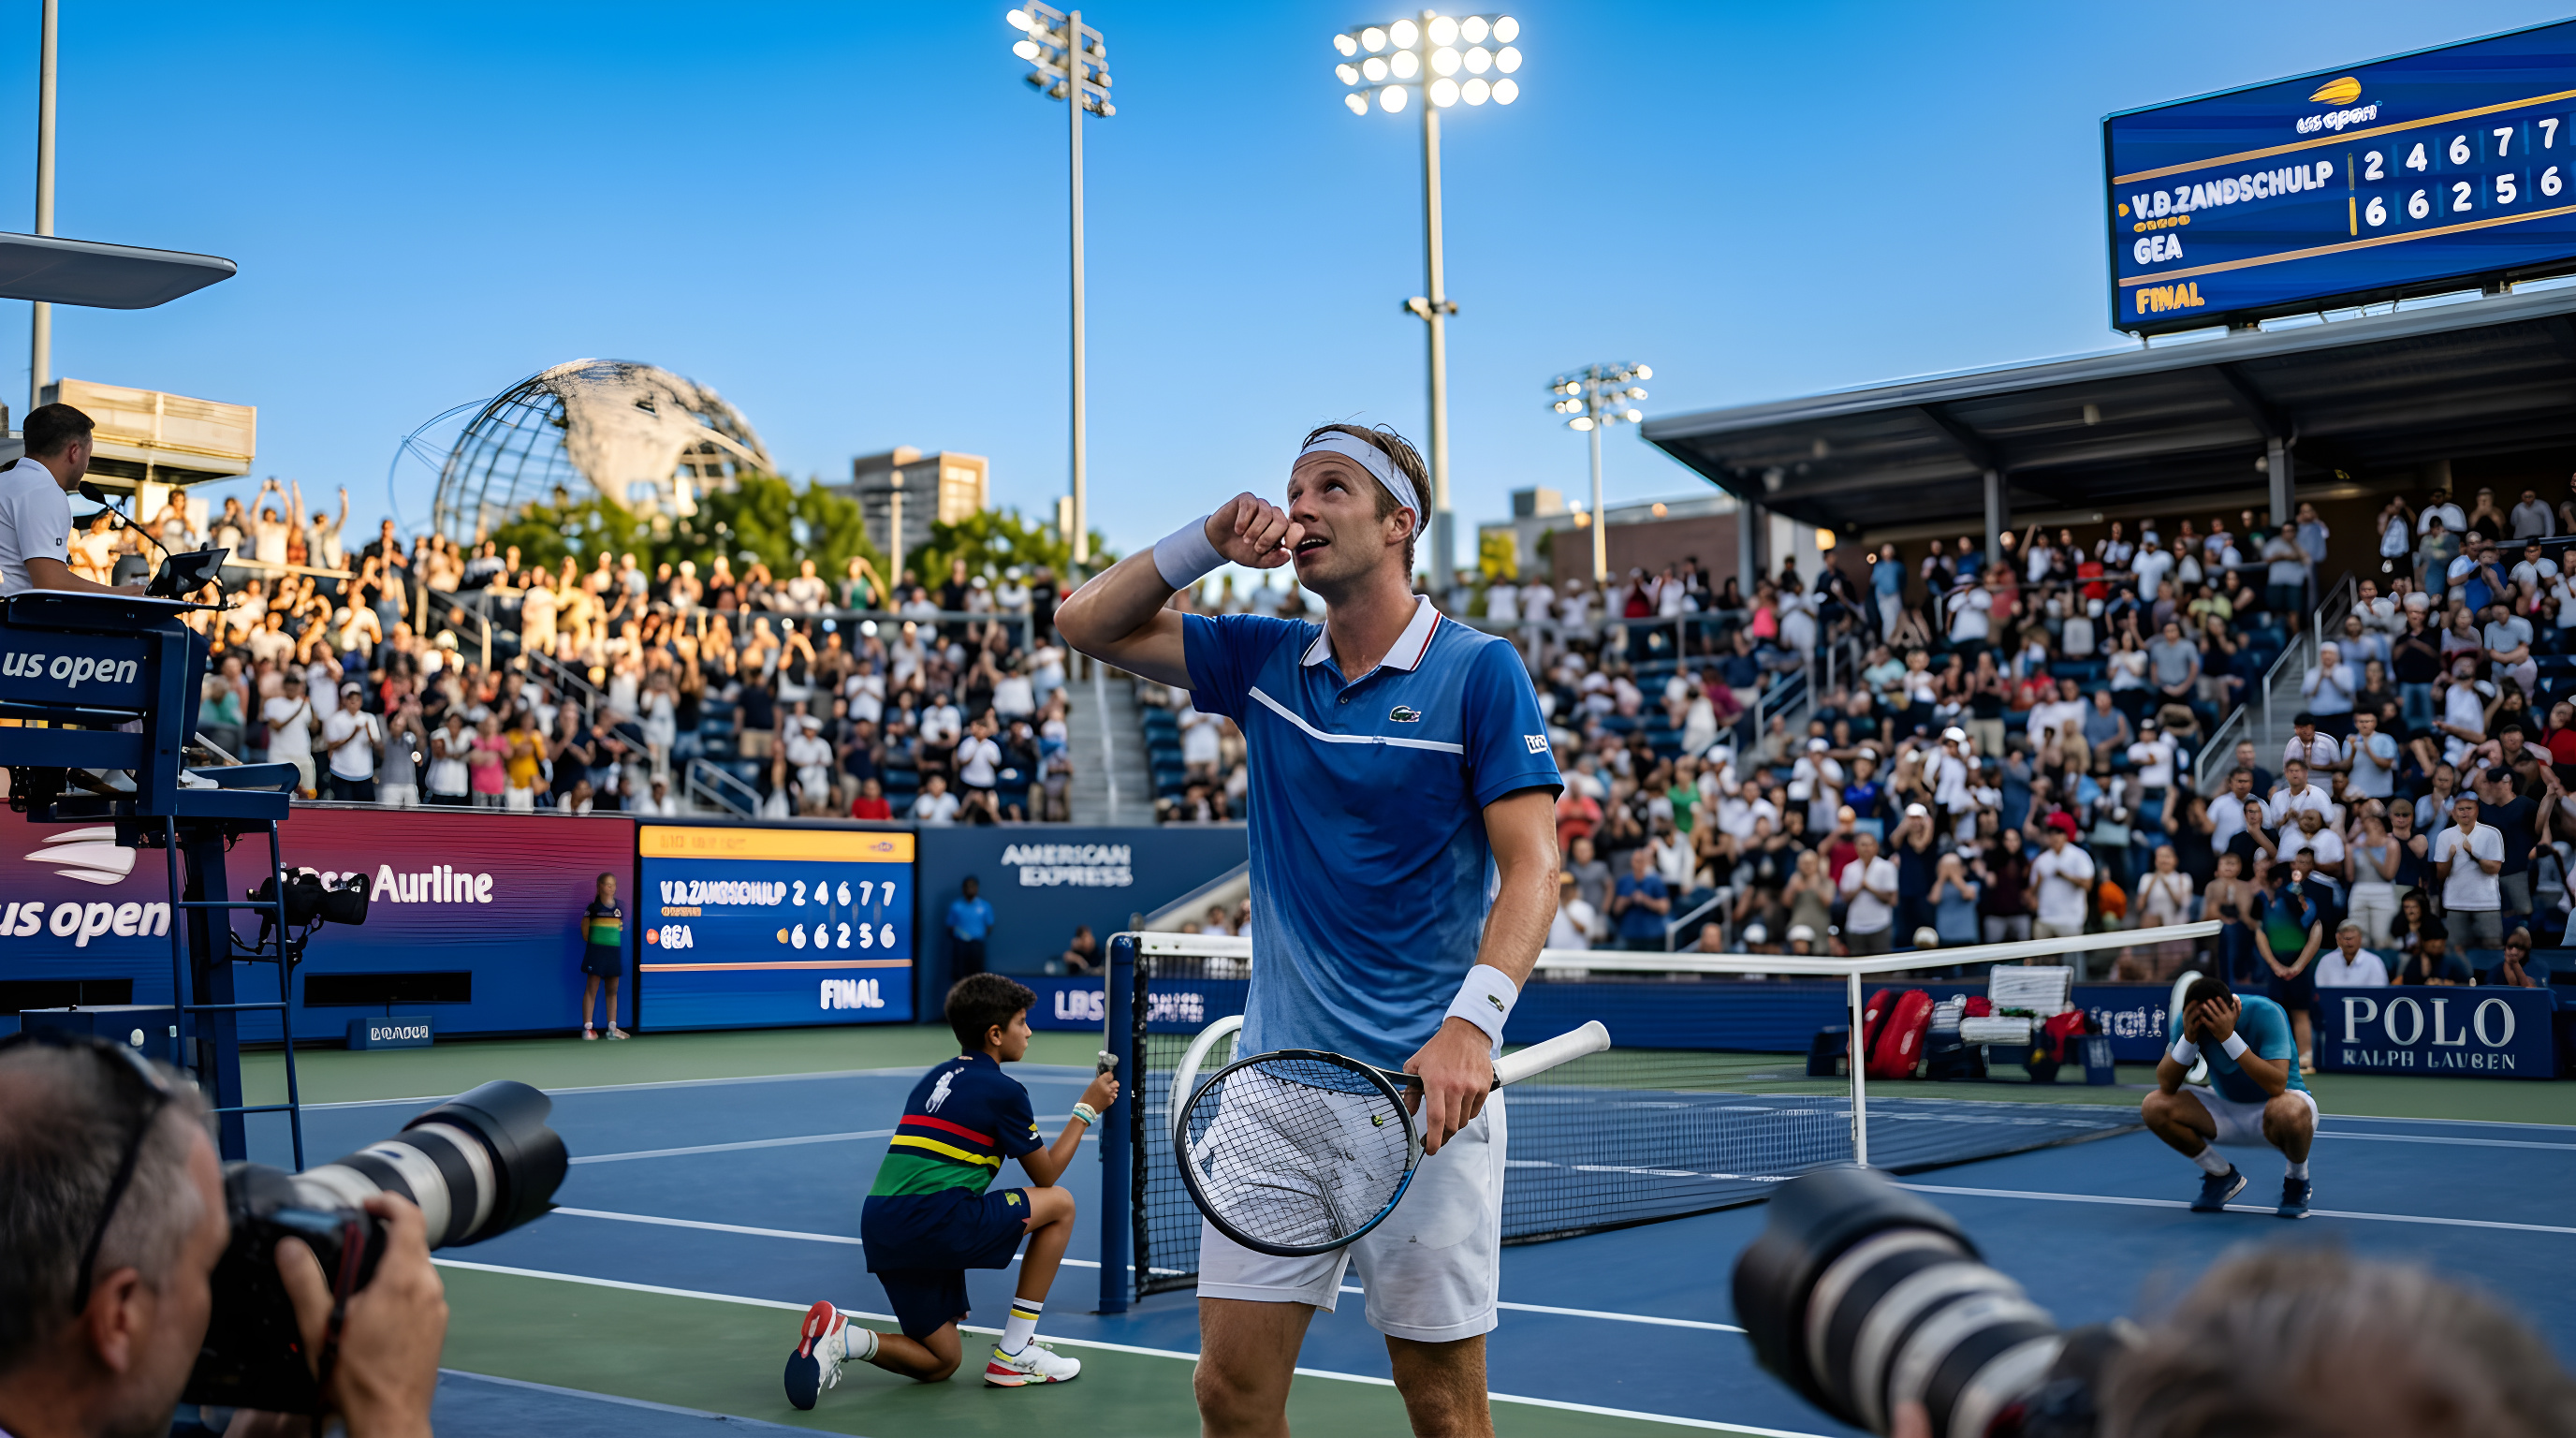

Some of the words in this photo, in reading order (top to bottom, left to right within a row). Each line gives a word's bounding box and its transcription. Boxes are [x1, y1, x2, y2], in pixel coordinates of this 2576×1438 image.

[2364, 151, 2384, 181] 2
[2406, 142, 2427, 171] 4
[2449, 135, 2470, 165] 6
[2493, 126, 2513, 156] 7
[2539, 118, 2559, 149] 7
[2133, 233, 2183, 264] GEA
[2365, 197, 2387, 227] 6
[2408, 189, 2430, 219] 6
[2452, 182, 2472, 212] 2
[2496, 173, 2517, 204] 5
[2540, 166, 2563, 196] 6
[2135, 282, 2205, 314] FINAL
[2, 652, 46, 678] us
[49, 655, 139, 688] open
[1001, 844, 1132, 866] AMERICAN
[370, 864, 493, 903] Aurline
[792, 879, 807, 906] 2
[813, 880, 829, 905] 4
[837, 880, 852, 906] 6
[859, 880, 874, 906] 7
[881, 880, 896, 906] 7
[49, 902, 171, 947] open
[791, 923, 807, 949] 6
[813, 923, 829, 949] 6
[836, 922, 851, 948] 2
[880, 923, 896, 948] 6
[2341, 996, 2516, 1048] POLO
